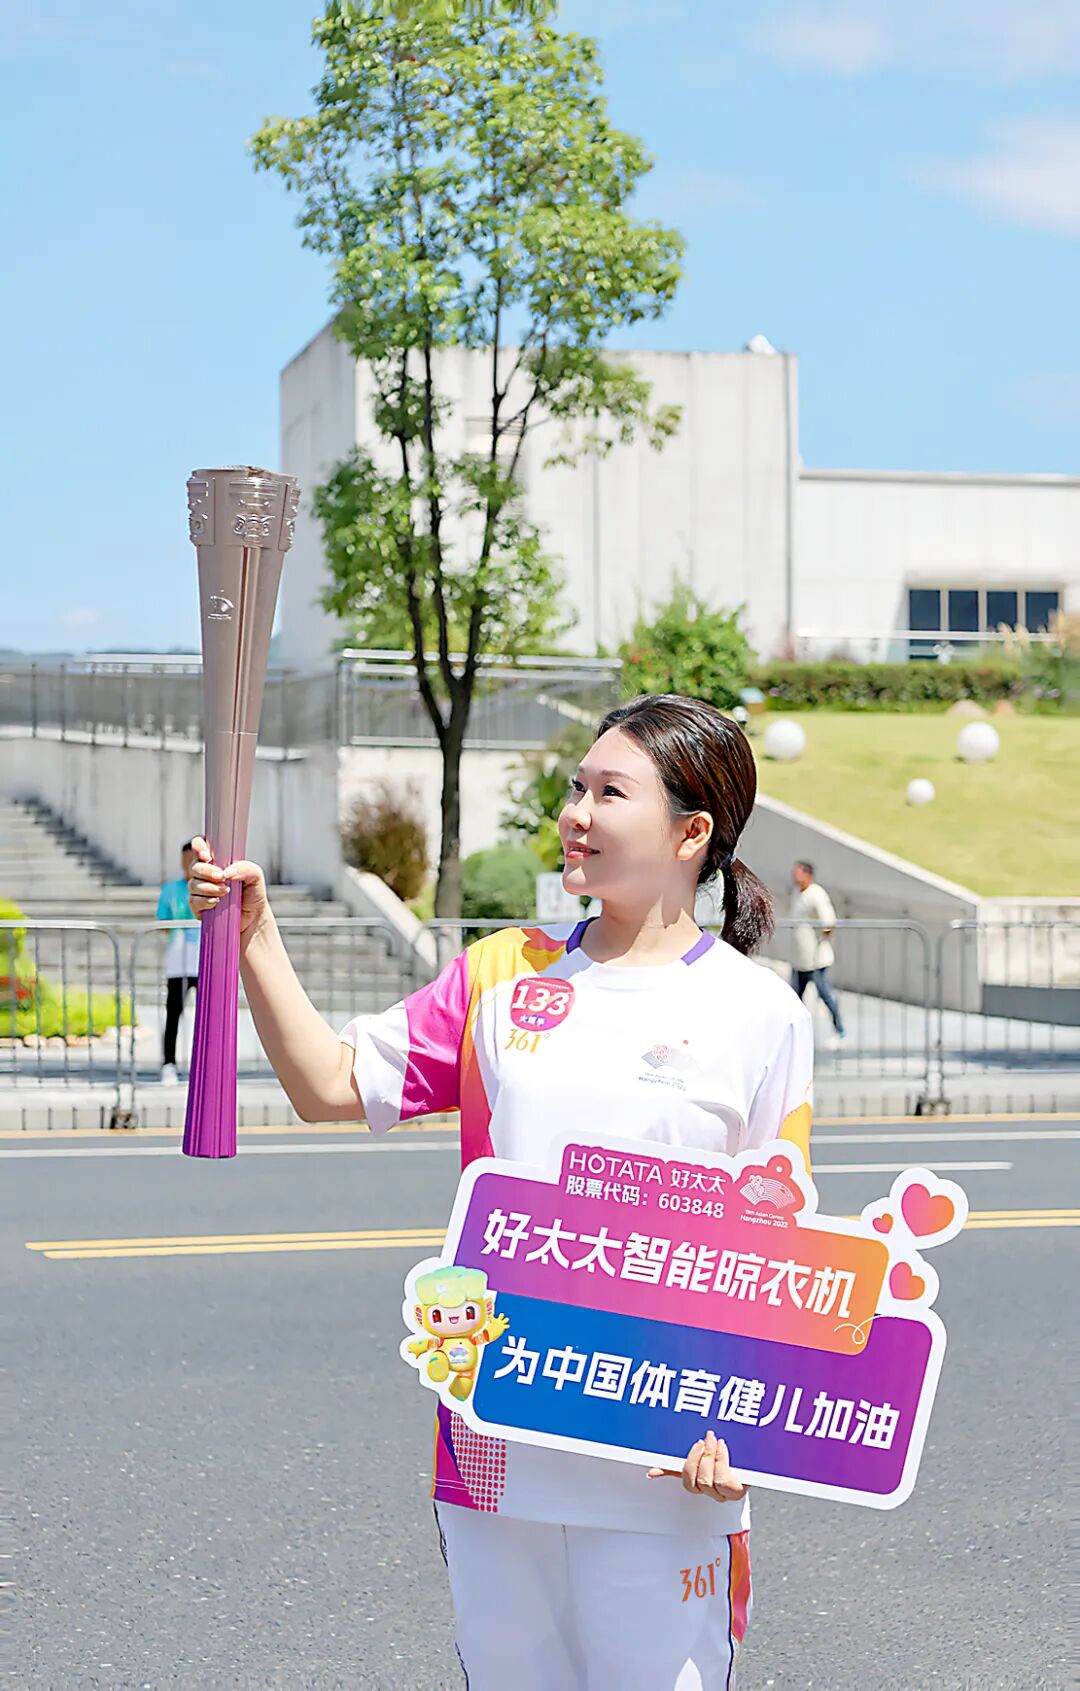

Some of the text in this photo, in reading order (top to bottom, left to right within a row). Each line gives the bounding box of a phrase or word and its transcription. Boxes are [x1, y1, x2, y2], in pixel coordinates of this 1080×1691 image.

[511, 985, 570, 1016] 133
[569, 1151, 727, 1195] HOTATA 好太太
[740, 1215, 788, 1228] Hangzhou 2022
[481, 1208, 857, 1319] 好太太智能晾衣机
[493, 1335, 900, 1450] 为中国体育健儿加油
